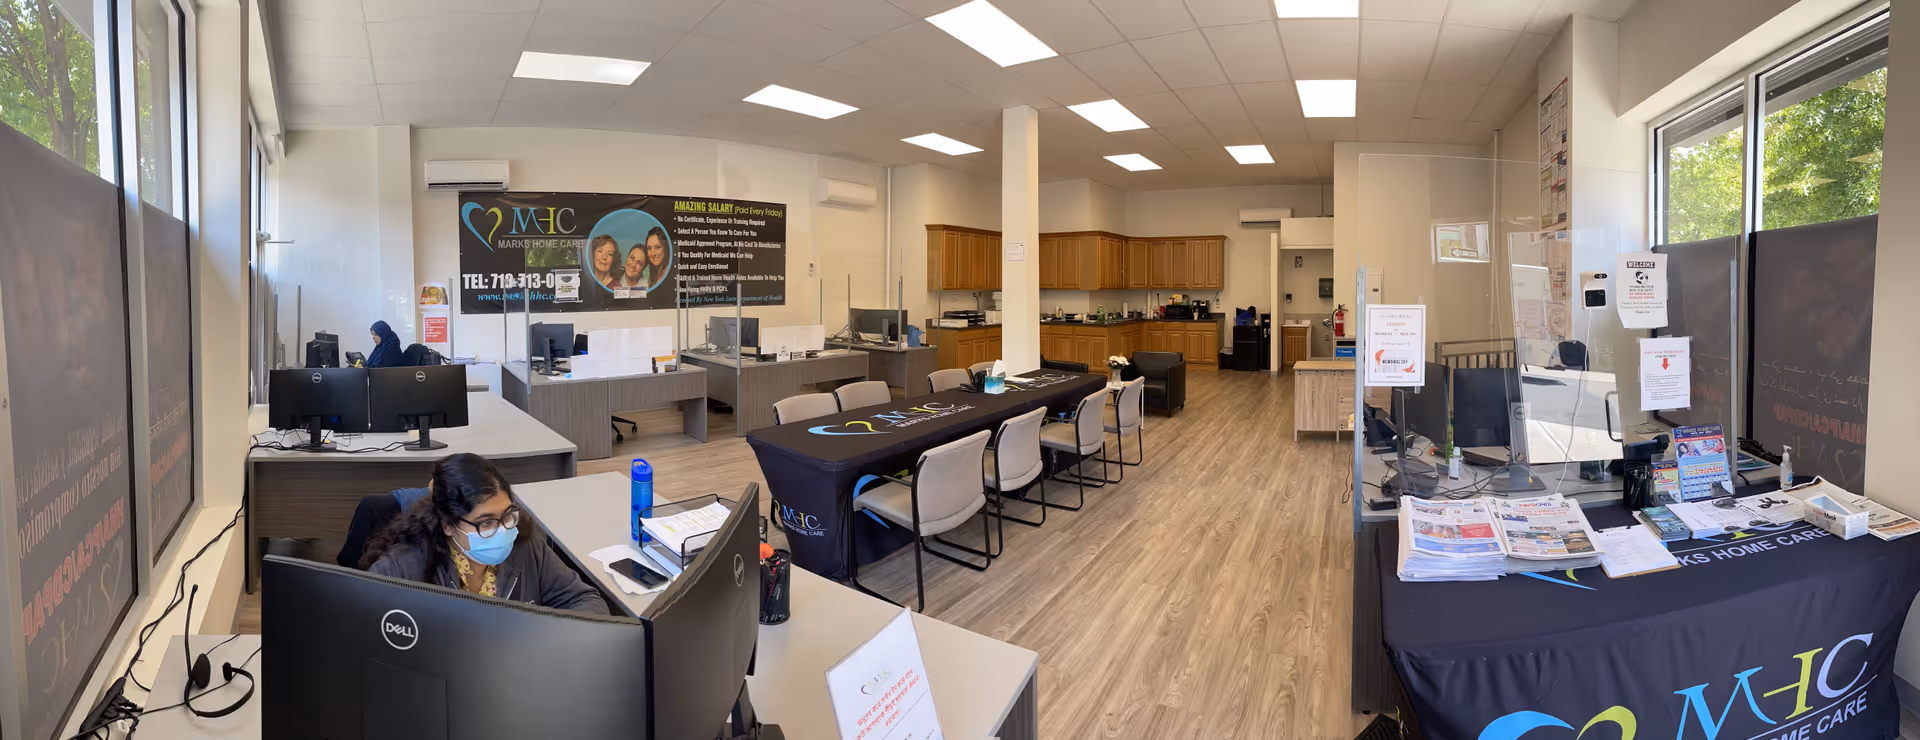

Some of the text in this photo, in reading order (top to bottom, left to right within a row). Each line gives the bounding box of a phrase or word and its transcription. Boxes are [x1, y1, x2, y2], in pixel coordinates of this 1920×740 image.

[674, 200, 706, 212] AMAZING
[708, 202, 733, 213] SALARY
[750, 208, 764, 216] Every
[508, 207, 577, 234] MHC
[498, 239, 584, 248] MARKS HOME CARE
[462, 274, 488, 289] TEL:
[870, 402, 955, 423] MHC
[782, 504, 820, 530] MHC
[1711, 540, 1778, 560] HOME
[1777, 528, 1831, 546] CARE
[385, 624, 415, 639] DELL
[1673, 632, 1874, 740] MHC
[1817, 690, 1867, 734] CARE
